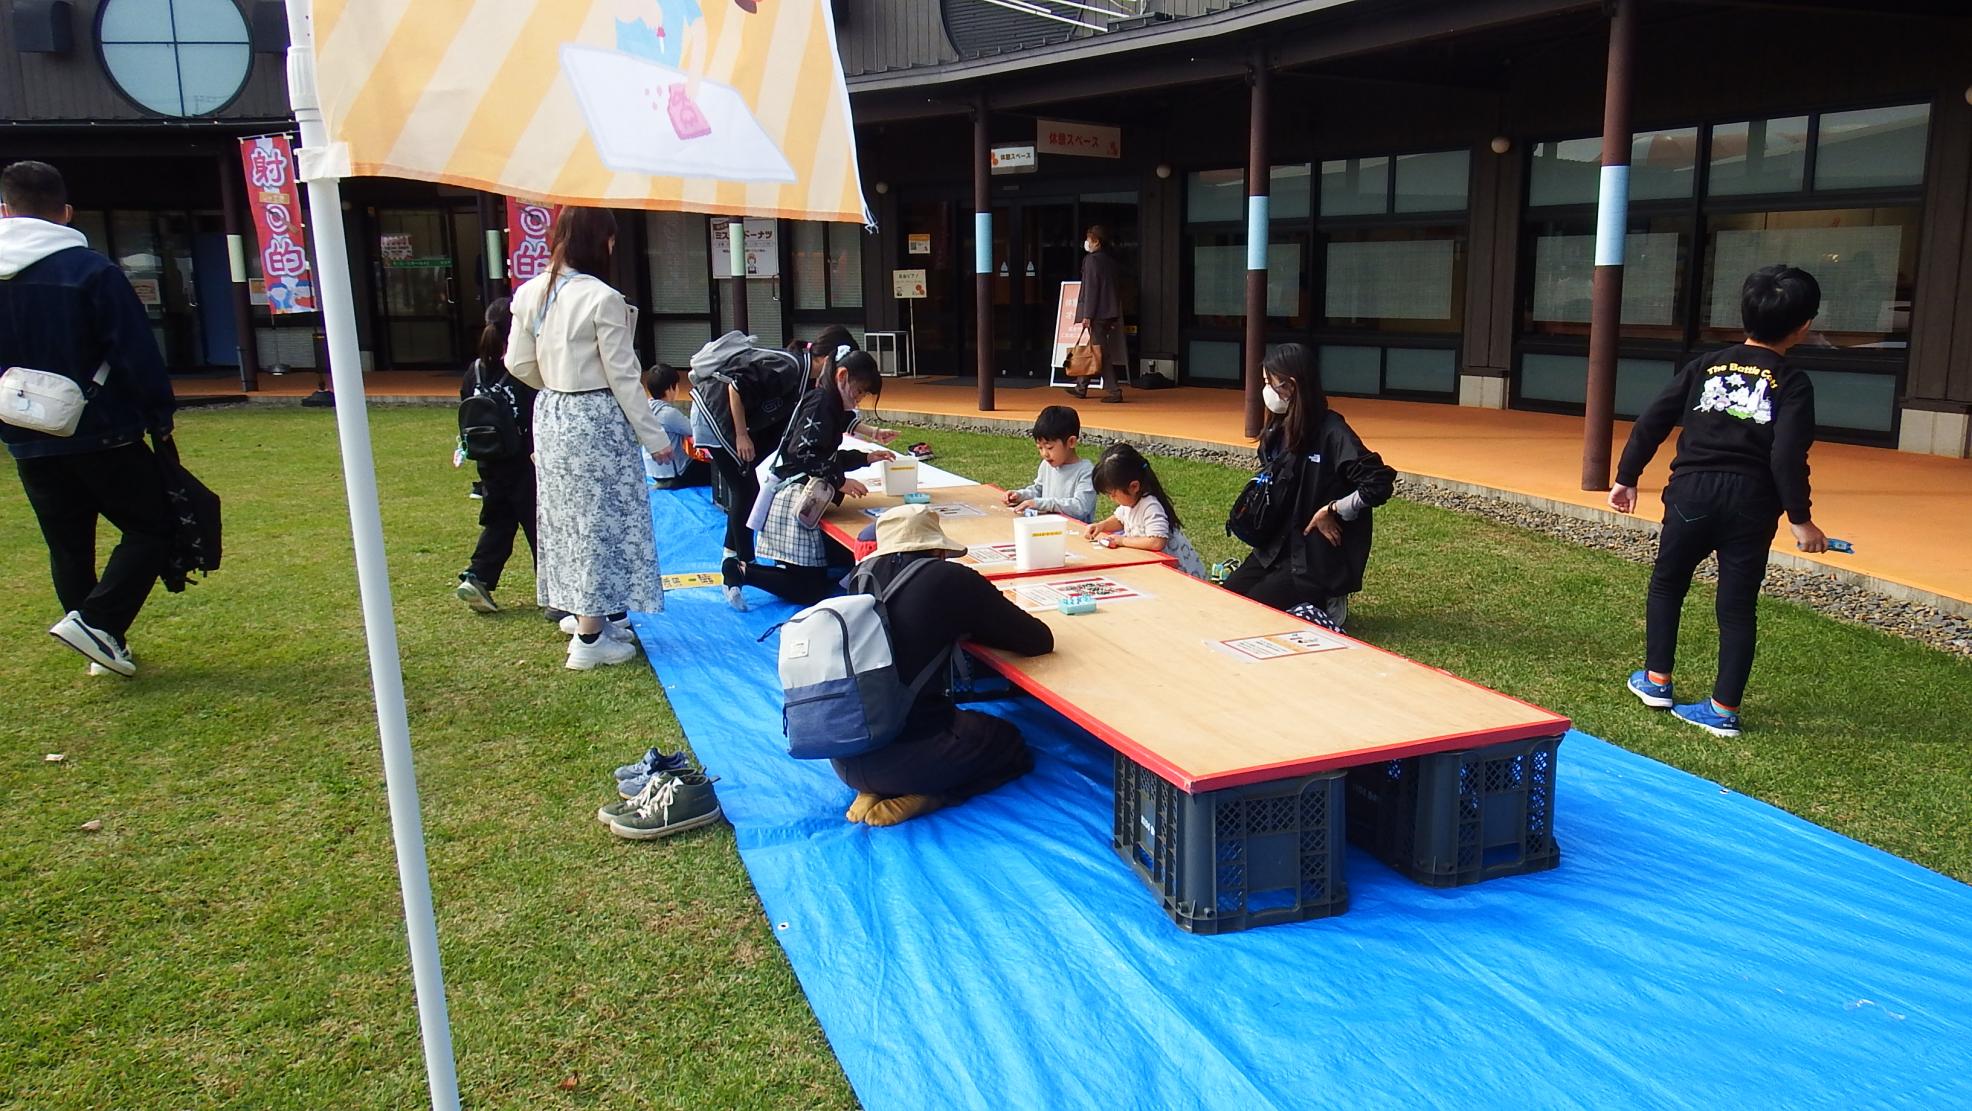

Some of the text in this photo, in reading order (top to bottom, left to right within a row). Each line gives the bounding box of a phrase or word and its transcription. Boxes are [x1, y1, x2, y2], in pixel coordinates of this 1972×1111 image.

[1049, 132, 1099, 148] 休憩スペース
[1000, 152, 1031, 161] 休憩スペース
[715, 231, 773, 240] ミスドーナツ
[1707, 364, 1727, 375] The
[1729, 363, 1760, 375] Battle
